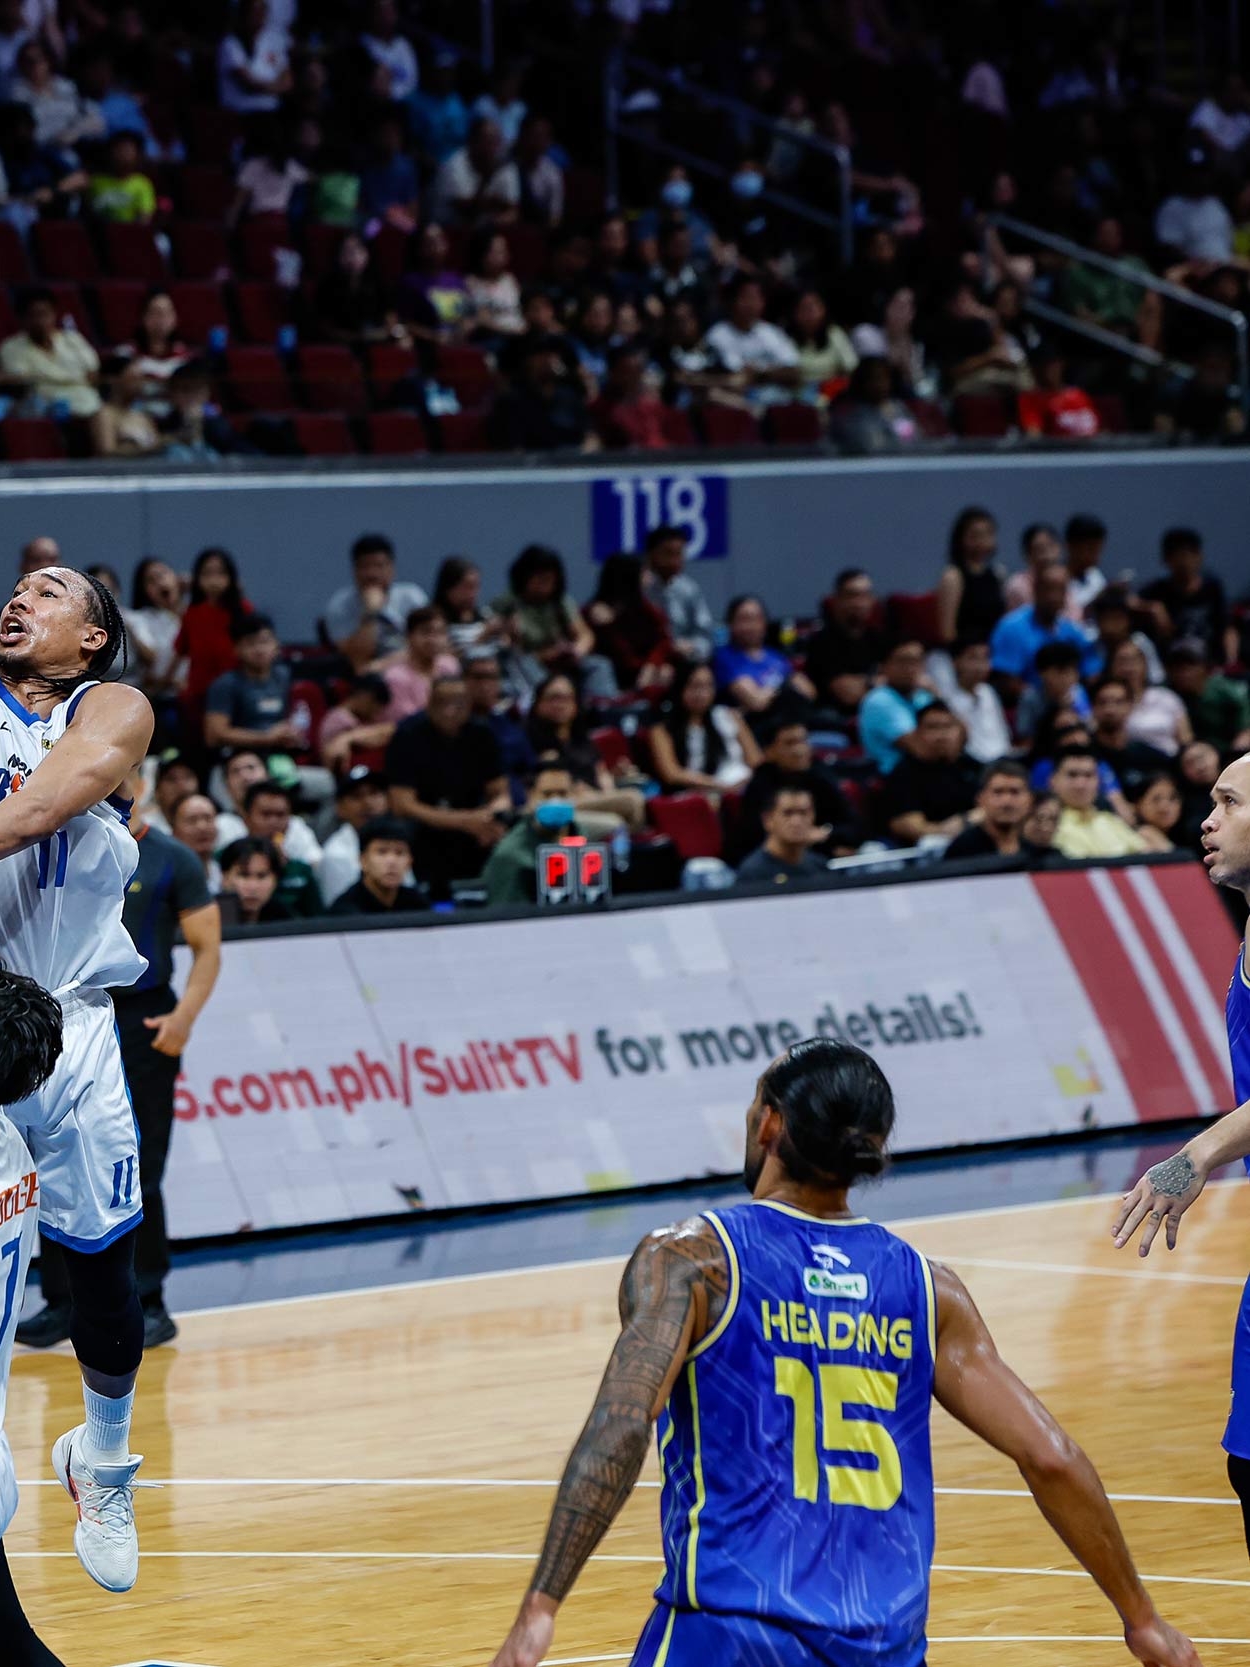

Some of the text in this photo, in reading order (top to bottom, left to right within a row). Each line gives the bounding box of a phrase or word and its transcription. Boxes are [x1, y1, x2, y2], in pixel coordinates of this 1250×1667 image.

[611, 474, 708, 560] 118
[595, 1028, 665, 1077] for
[679, 1017, 802, 1069] more
[814, 991, 983, 1047] details!
[110, 1153, 134, 1209] 11
[761, 1299, 912, 1359] HEADING
[773, 1355, 903, 1511] 15
